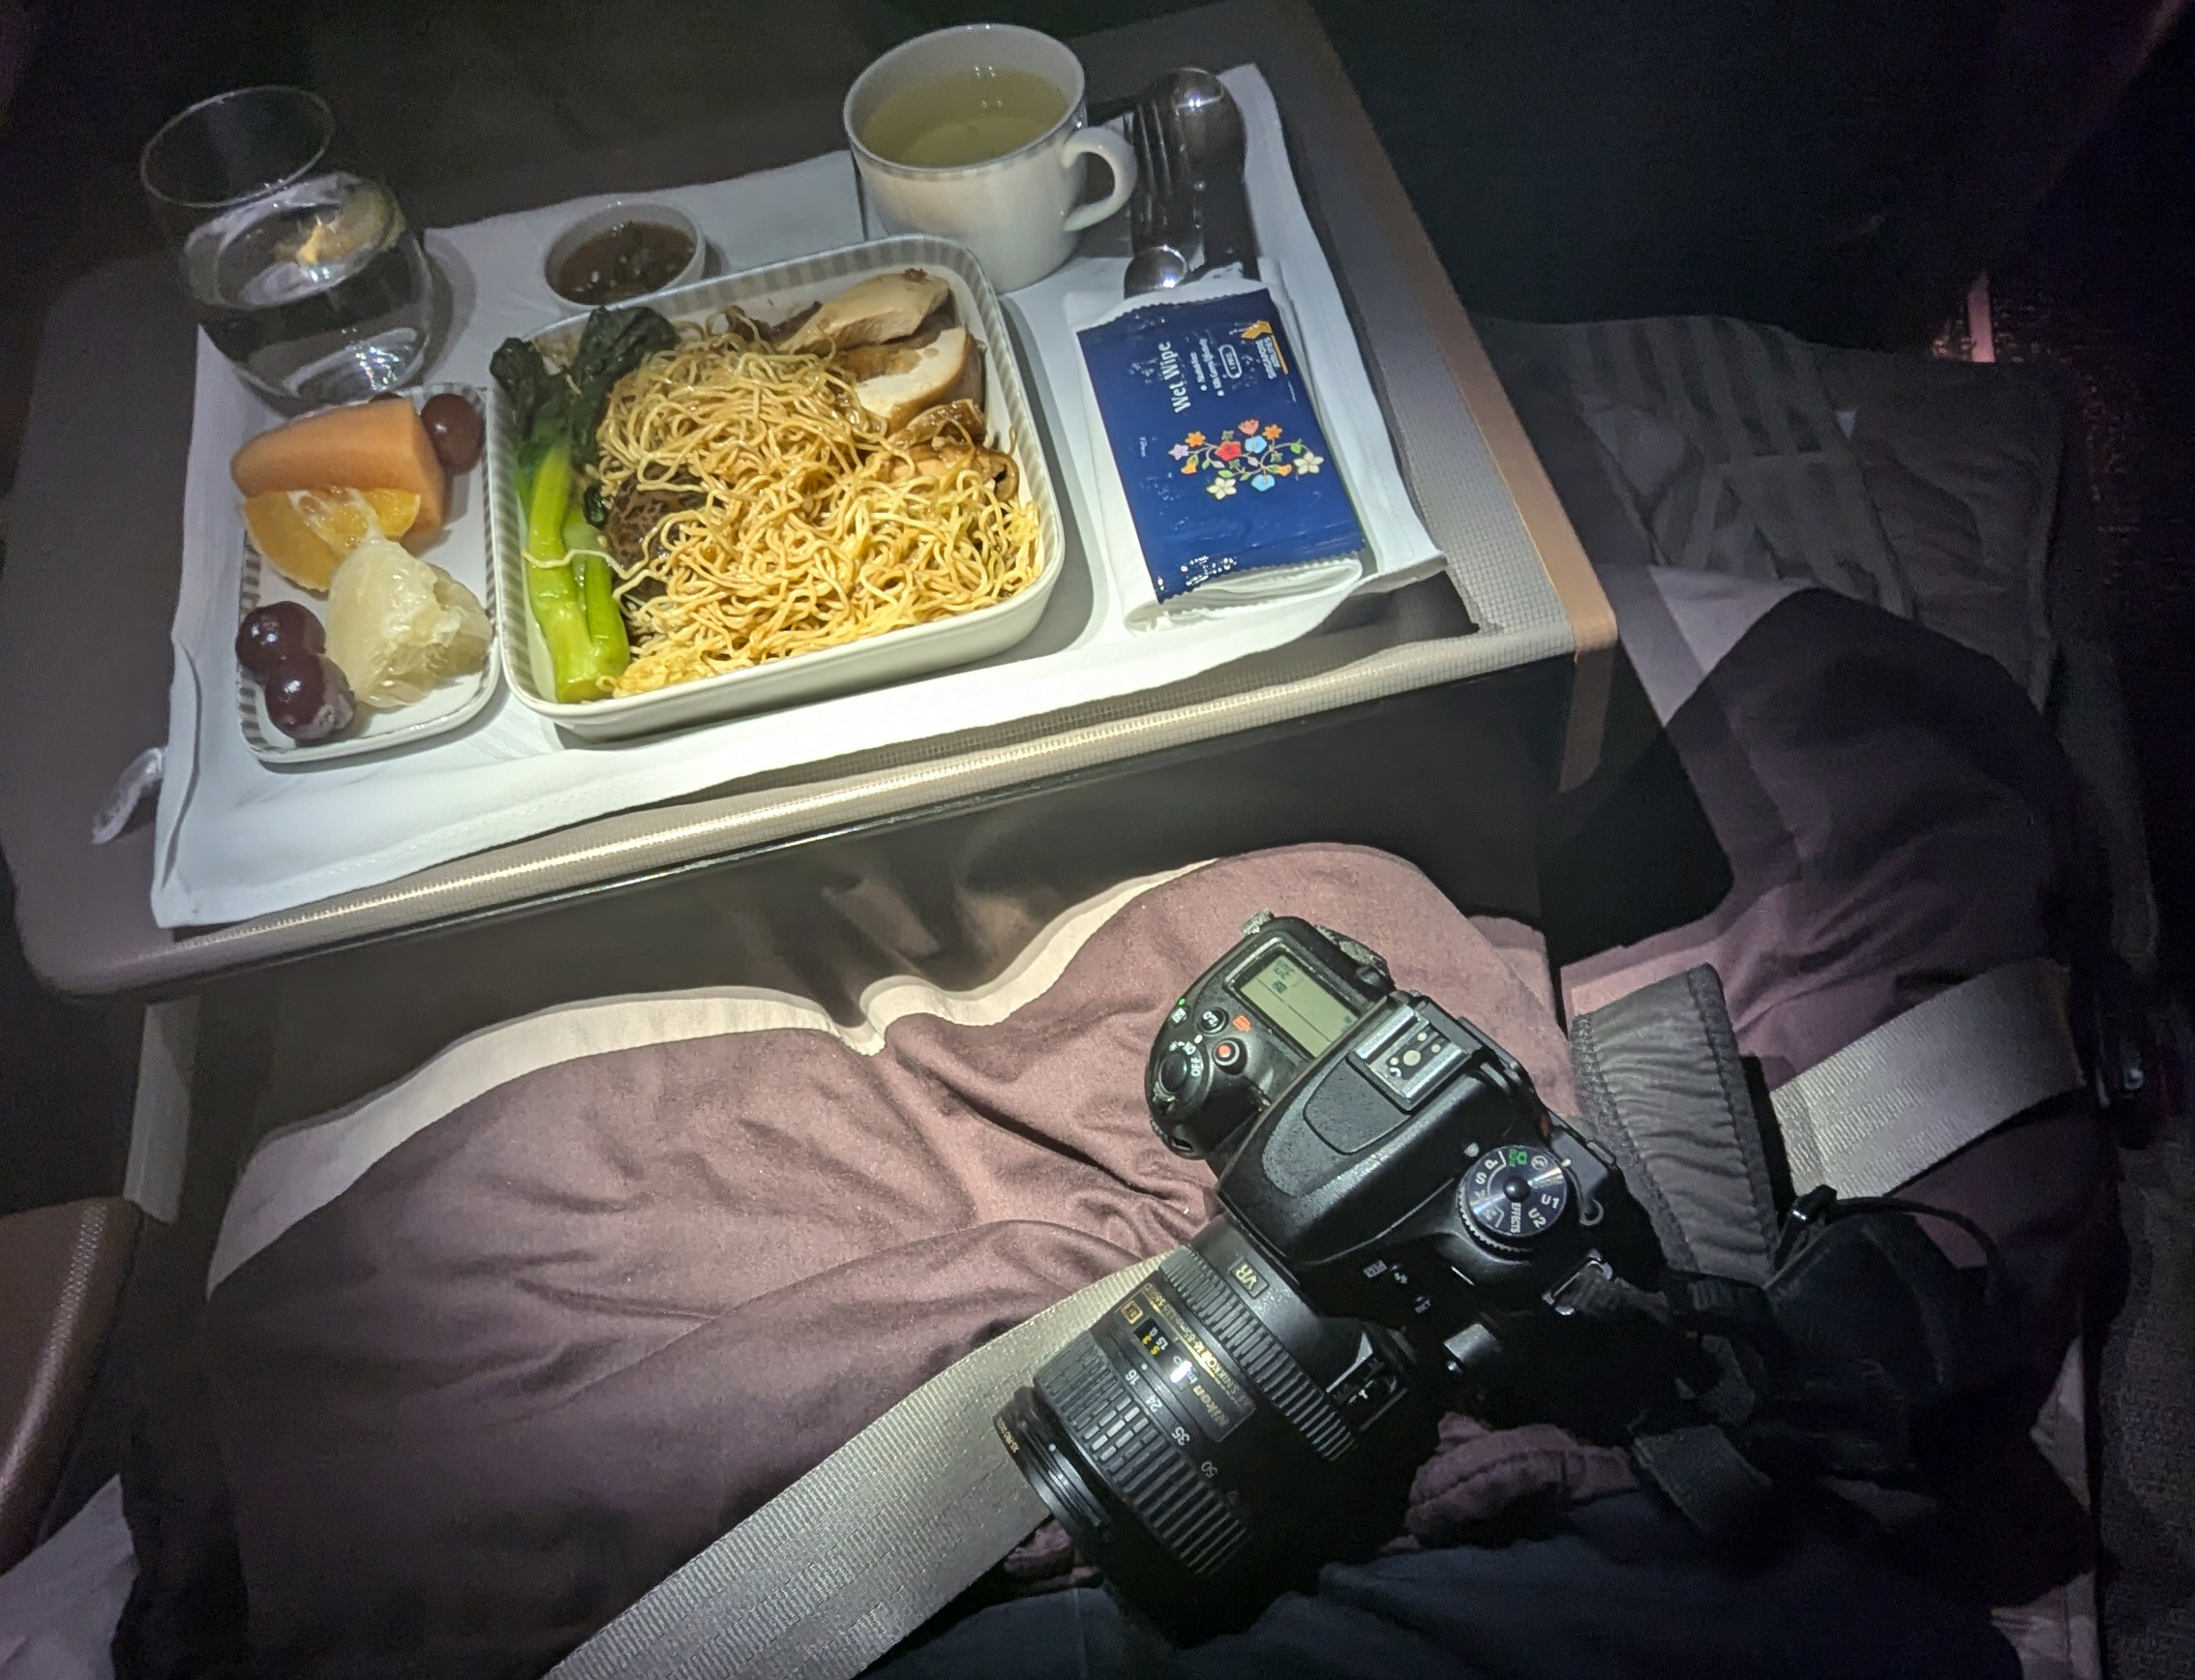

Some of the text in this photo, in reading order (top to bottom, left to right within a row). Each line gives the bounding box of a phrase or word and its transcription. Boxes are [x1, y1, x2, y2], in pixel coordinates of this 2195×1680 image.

[1158, 342, 1190, 413] Wet Wipe
[1190, 1057, 1202, 1077] OFF
[1484, 1158, 1498, 1170] P
[1475, 1172, 1488, 1185] S
[1541, 1193, 1559, 1209] U1
[1510, 1202, 1521, 1233] EFFECTS
[1528, 1207, 1547, 1228] U2
[1235, 1264, 1257, 1290] VR
[1126, 1369, 1140, 1386] 16
[1145, 1394, 1162, 1413] 24
[1193, 1385, 1229, 1426] Nikon
[1171, 1426, 1190, 1445] 35
[1201, 1460, 1219, 1478] 50
